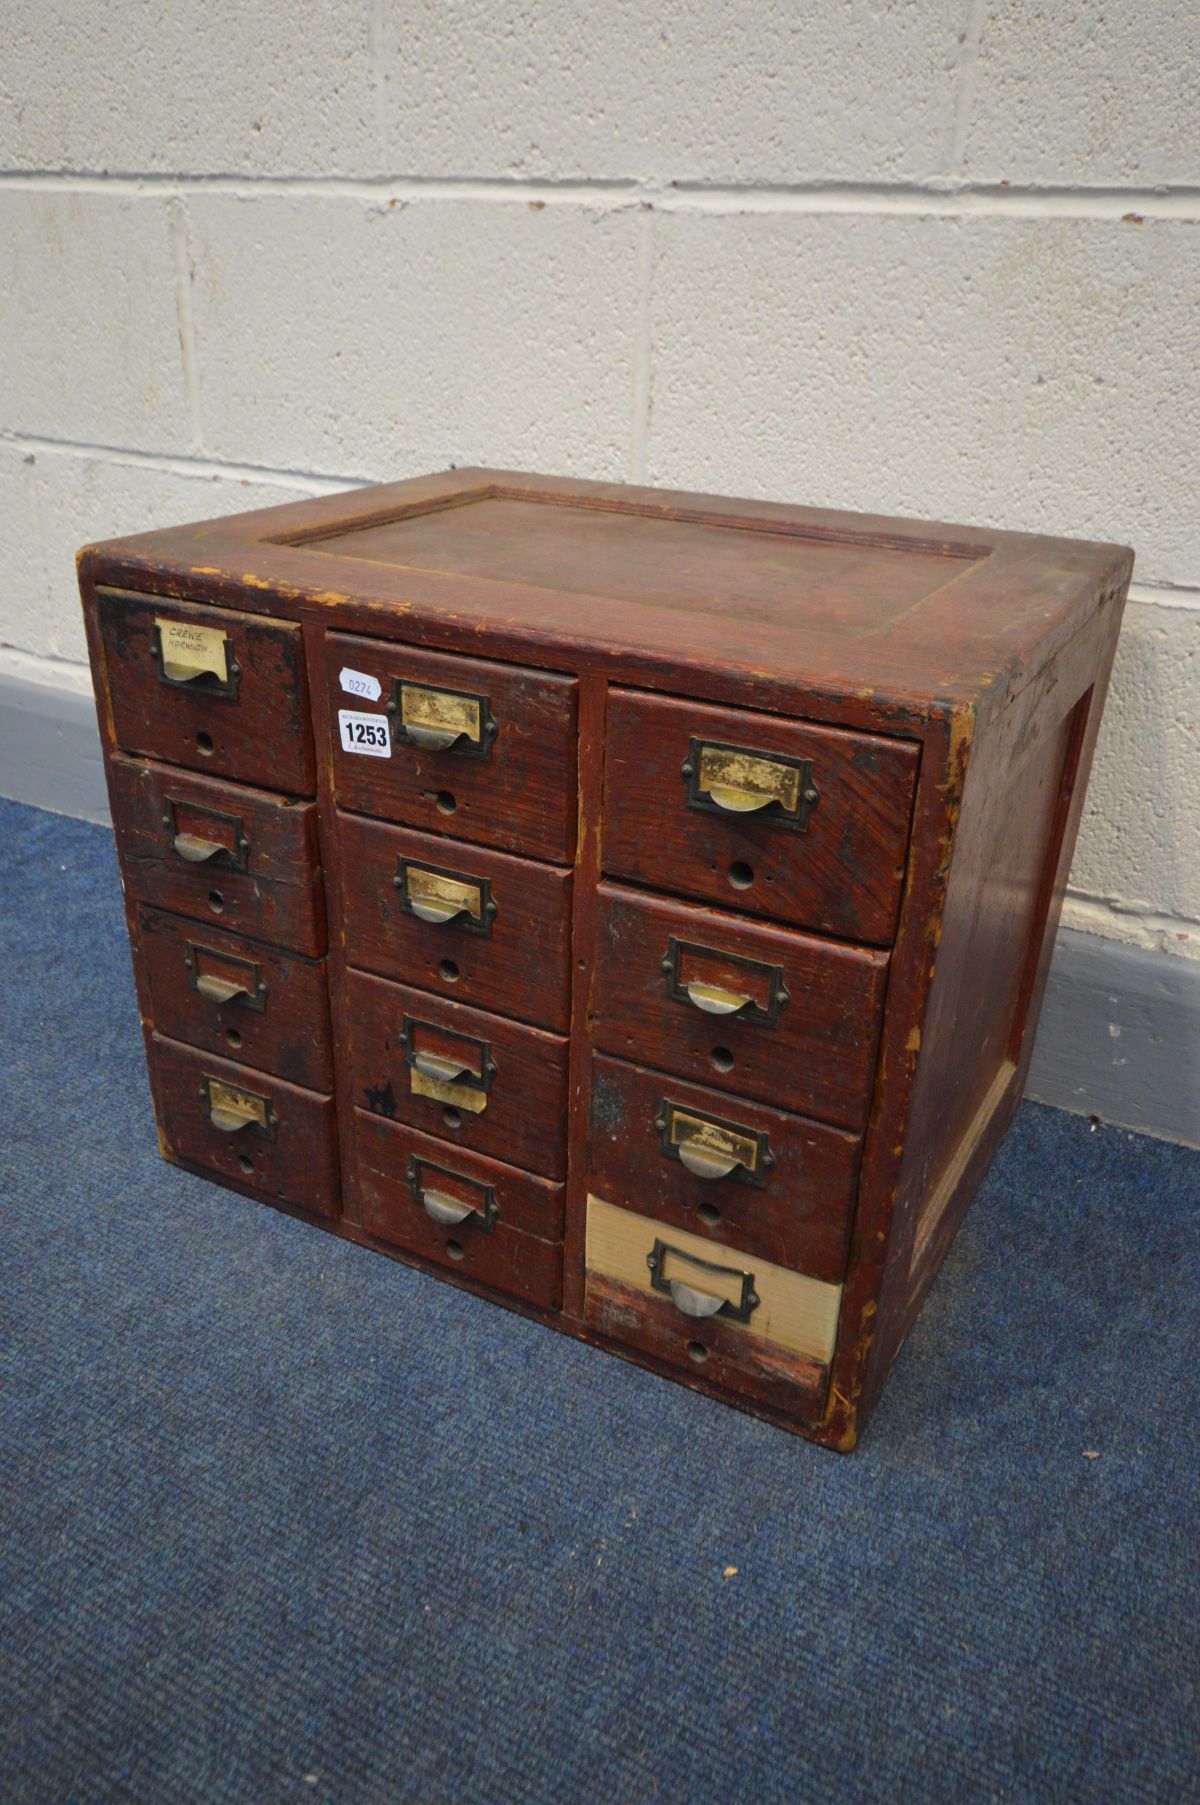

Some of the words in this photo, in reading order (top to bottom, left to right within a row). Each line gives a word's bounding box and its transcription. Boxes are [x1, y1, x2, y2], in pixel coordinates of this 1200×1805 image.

[169, 628, 204, 641] CREWE
[348, 680, 371, 696] 0274
[346, 722, 388, 747] 1253
